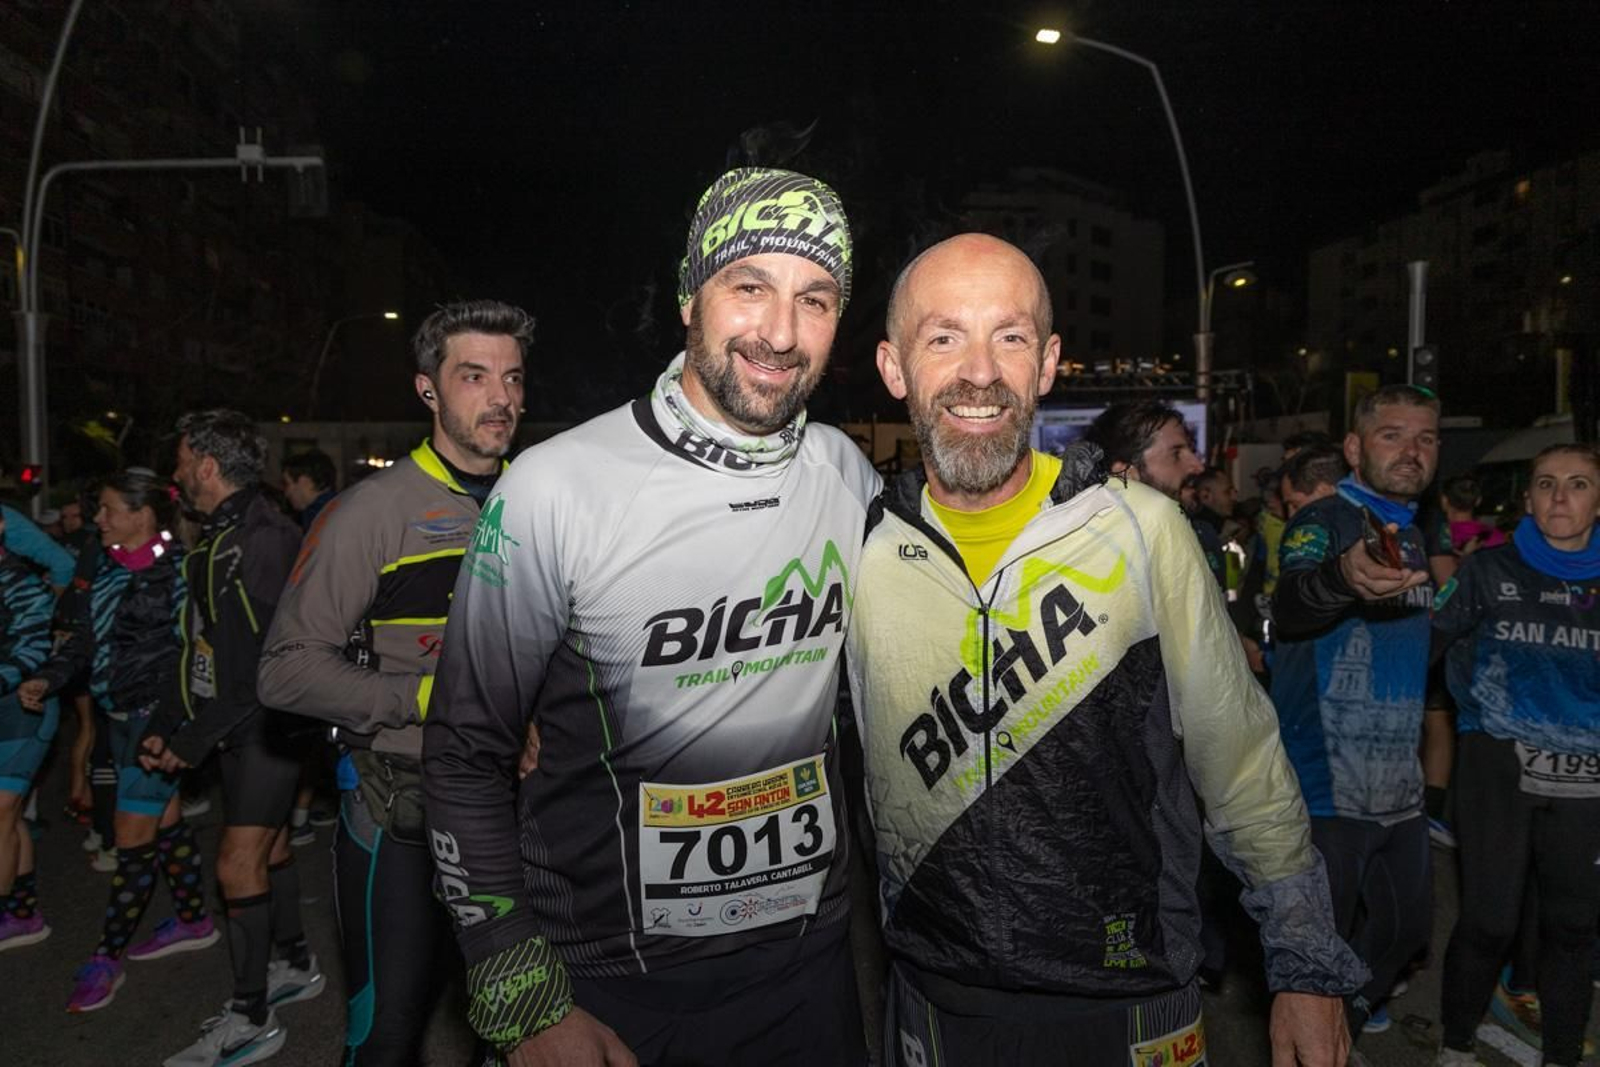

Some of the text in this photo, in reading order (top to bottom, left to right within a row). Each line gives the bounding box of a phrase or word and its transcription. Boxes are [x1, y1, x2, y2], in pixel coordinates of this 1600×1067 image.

[714, 235, 837, 268] TRAIL MOUNTAIN
[675, 430, 764, 471] BIC
[641, 582, 844, 668] BICHA
[1493, 620, 1546, 644] SAN
[674, 646, 828, 690] TRAIL MOUNTAIN
[900, 583, 1097, 792] BICHA
[1522, 746, 1600, 777] 7199
[687, 790, 727, 818] 42
[726, 798, 753, 815] SAN
[659, 804, 823, 880] 7013
[680, 862, 814, 895] ROBERTO TALAVERA CANTARELL
[1172, 1033, 1197, 1063] 42
